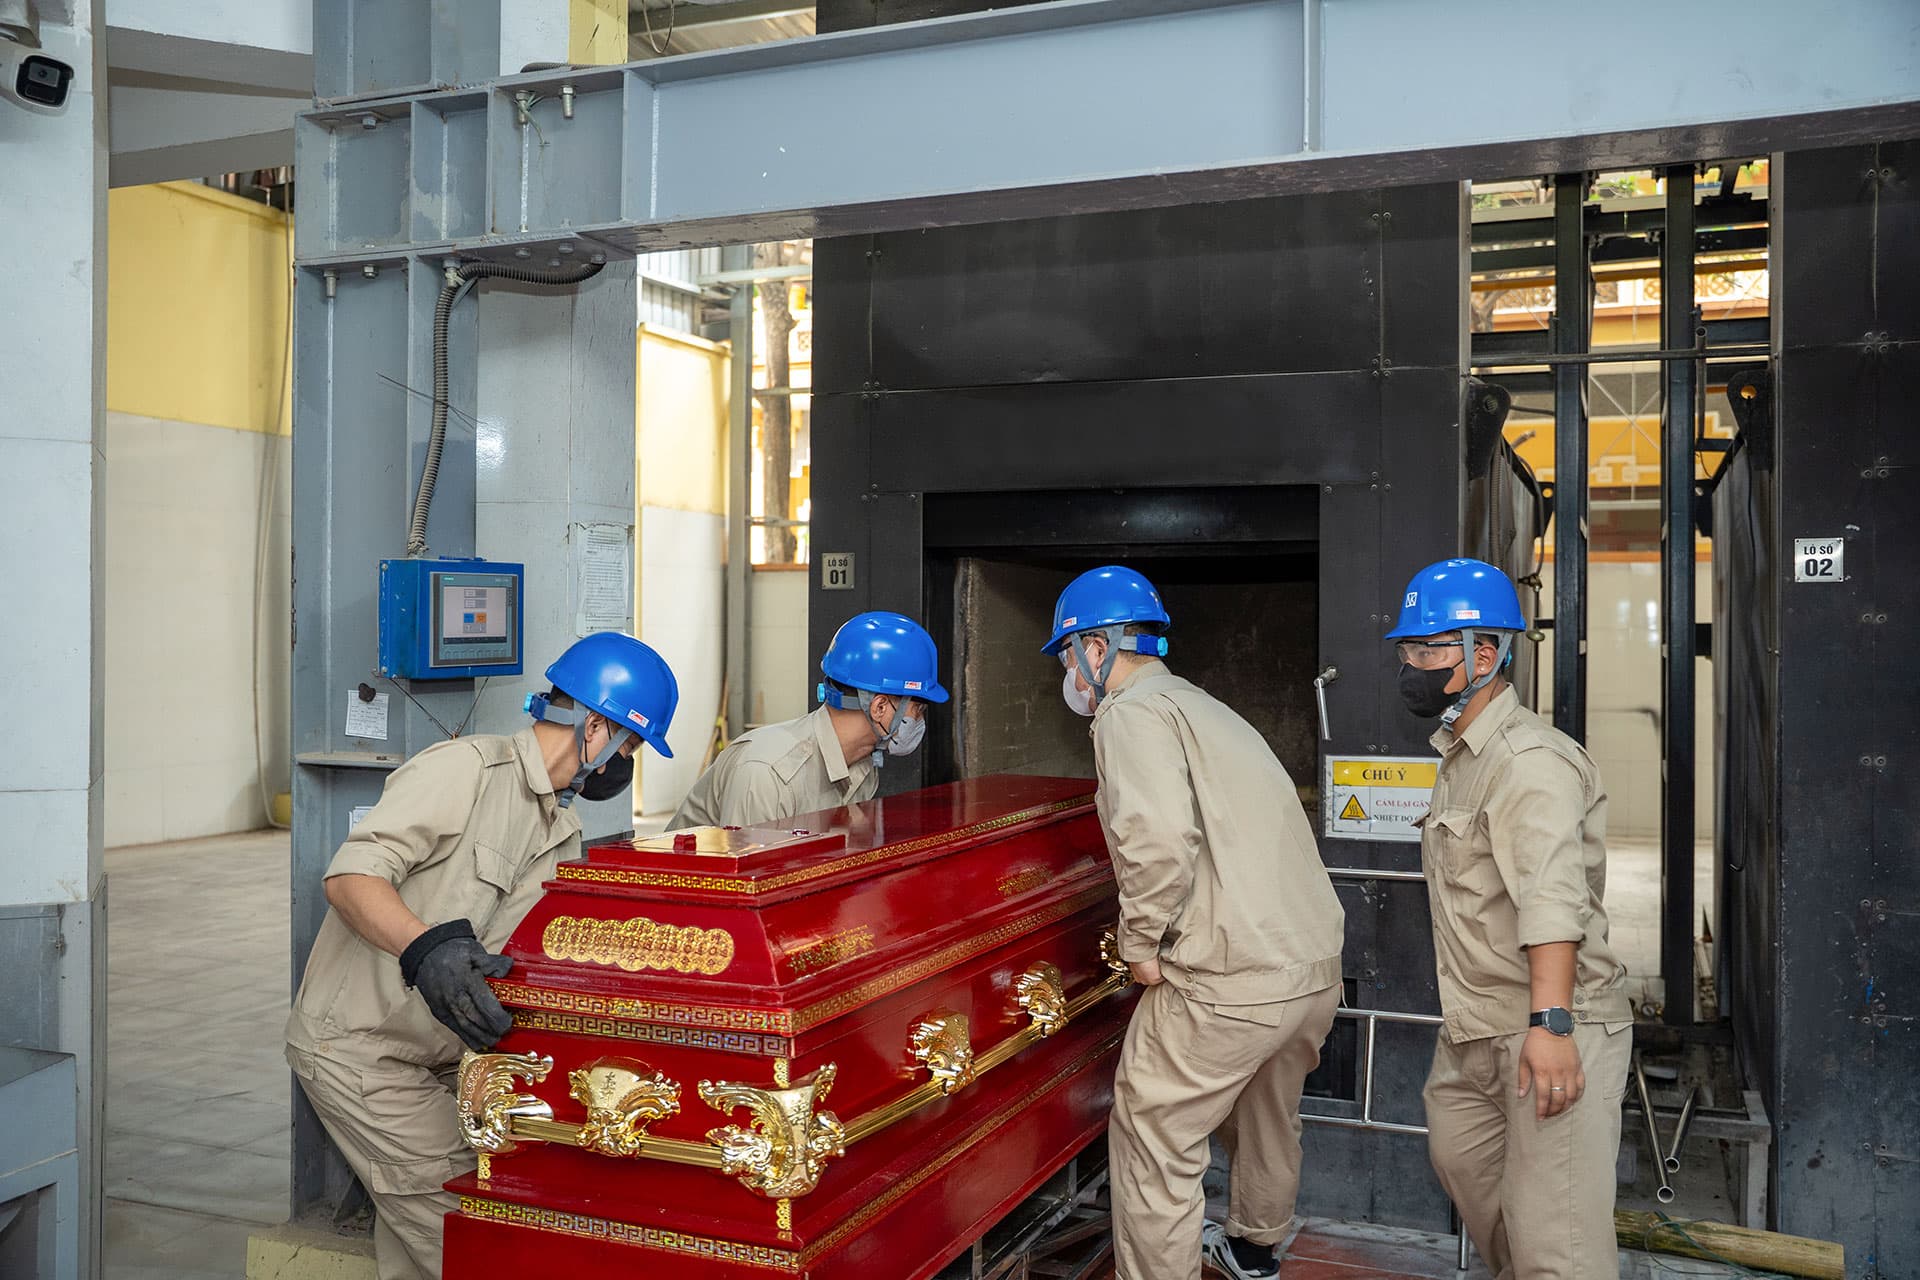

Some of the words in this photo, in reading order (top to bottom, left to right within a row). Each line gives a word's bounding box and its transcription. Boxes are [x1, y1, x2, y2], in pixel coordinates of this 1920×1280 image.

[1805, 558, 1833, 576] 02
[830, 569, 847, 585] 01
[1362, 767, 1393, 781] CHÚ
[1397, 767, 1407, 781] Ý
